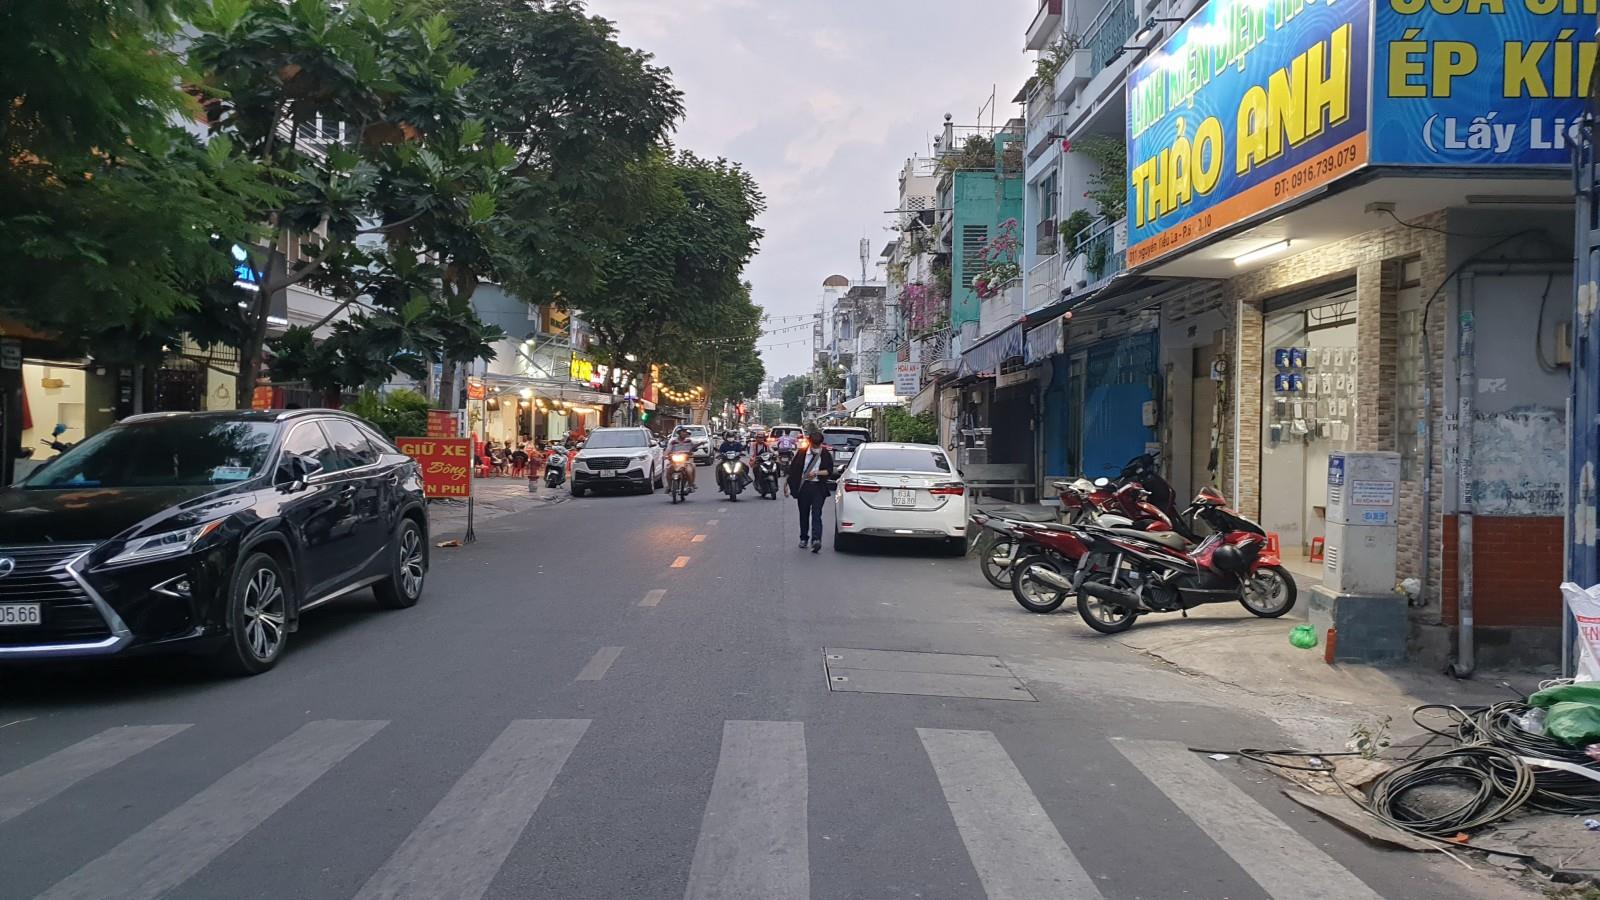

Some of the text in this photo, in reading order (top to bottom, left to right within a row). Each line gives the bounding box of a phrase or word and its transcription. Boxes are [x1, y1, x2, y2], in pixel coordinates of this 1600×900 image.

[1387, 28, 1479, 99] ÉP
[1131, 68, 1165, 140] LINH
[1132, 23, 1352, 229] THẢO ANH
[1274, 144, 1357, 197] ĐT: 0916.739.079
[401, 441, 467, 456] GIỮ XE
[426, 461, 467, 481] Bông
[441, 483, 467, 494] PHÍ
